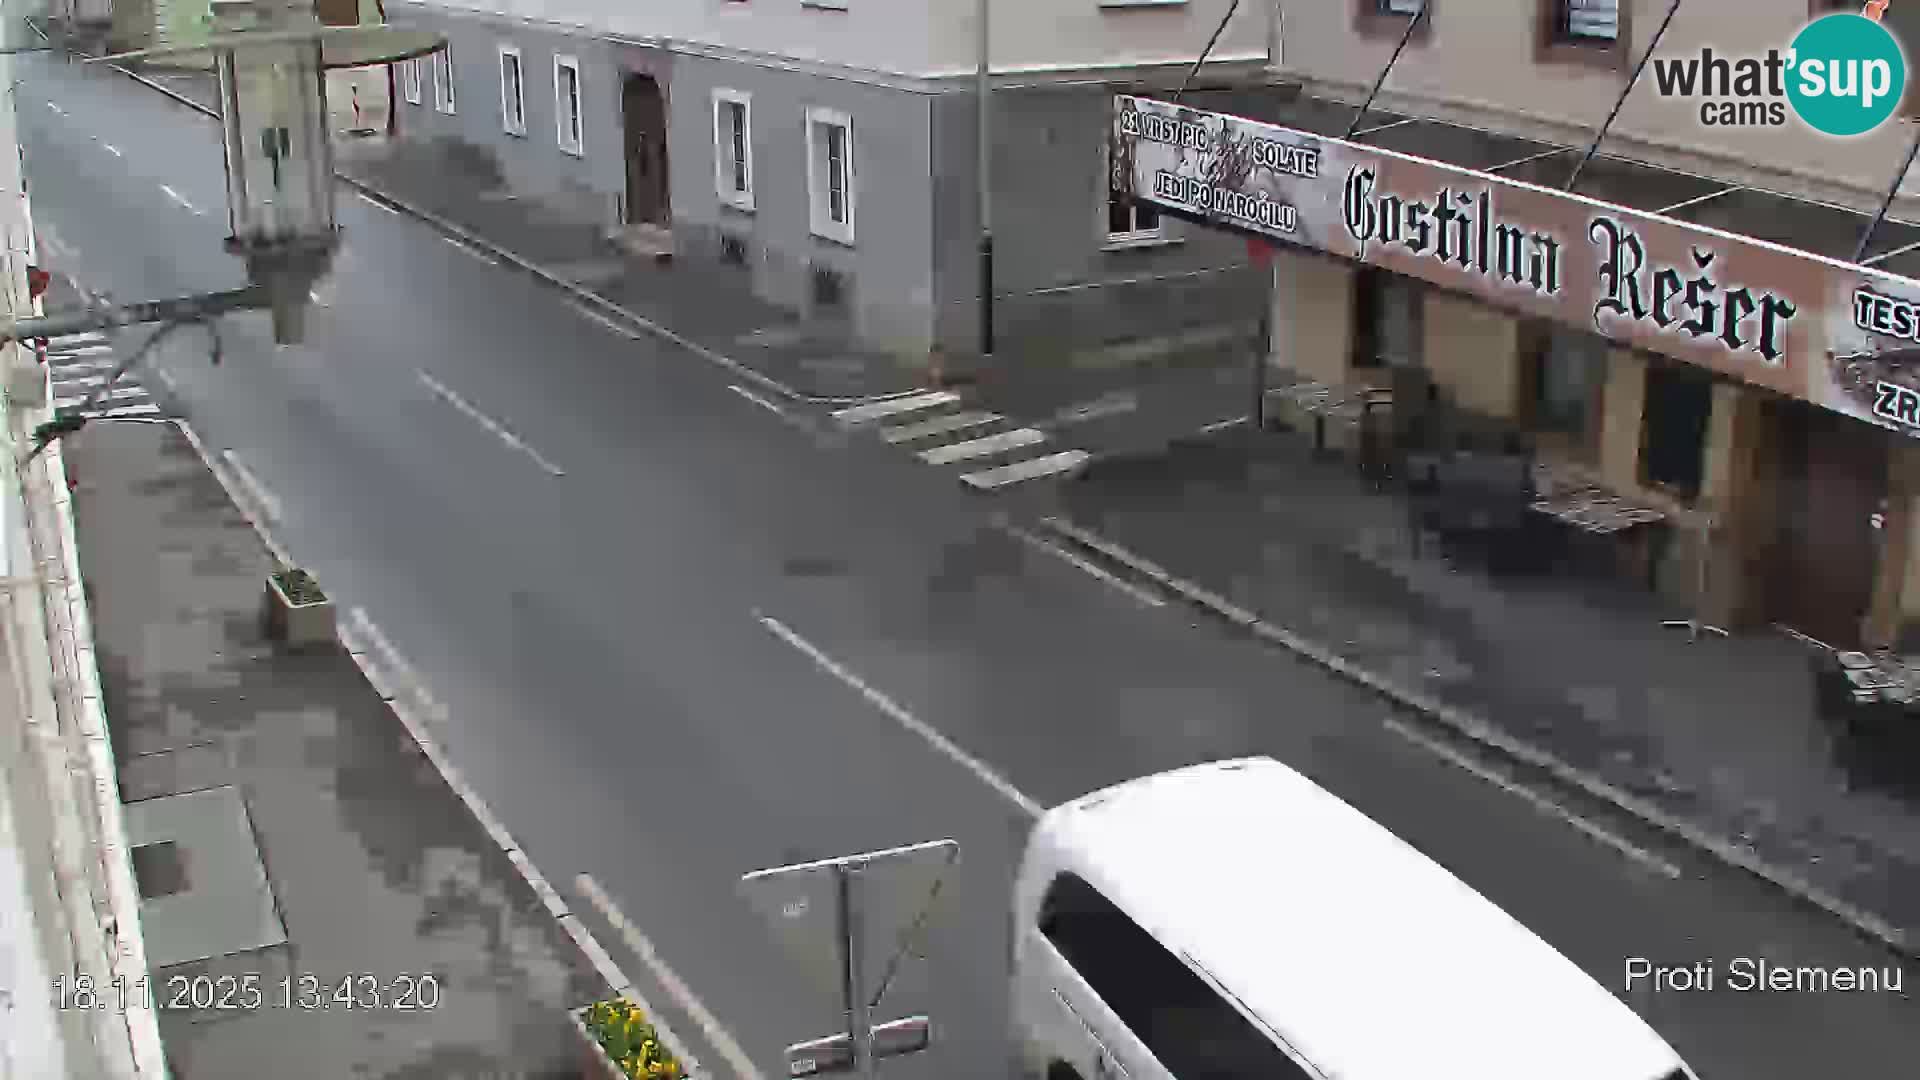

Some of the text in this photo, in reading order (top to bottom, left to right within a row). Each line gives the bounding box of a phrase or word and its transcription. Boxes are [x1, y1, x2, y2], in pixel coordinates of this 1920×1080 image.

[1252, 138, 1318, 176] SOLATE
[1154, 171, 1187, 203] JEDI
[1188, 178, 1212, 208] PO
[1343, 162, 1797, 362] Gostilna Rešer
[1872, 380, 1920, 429] ZR
